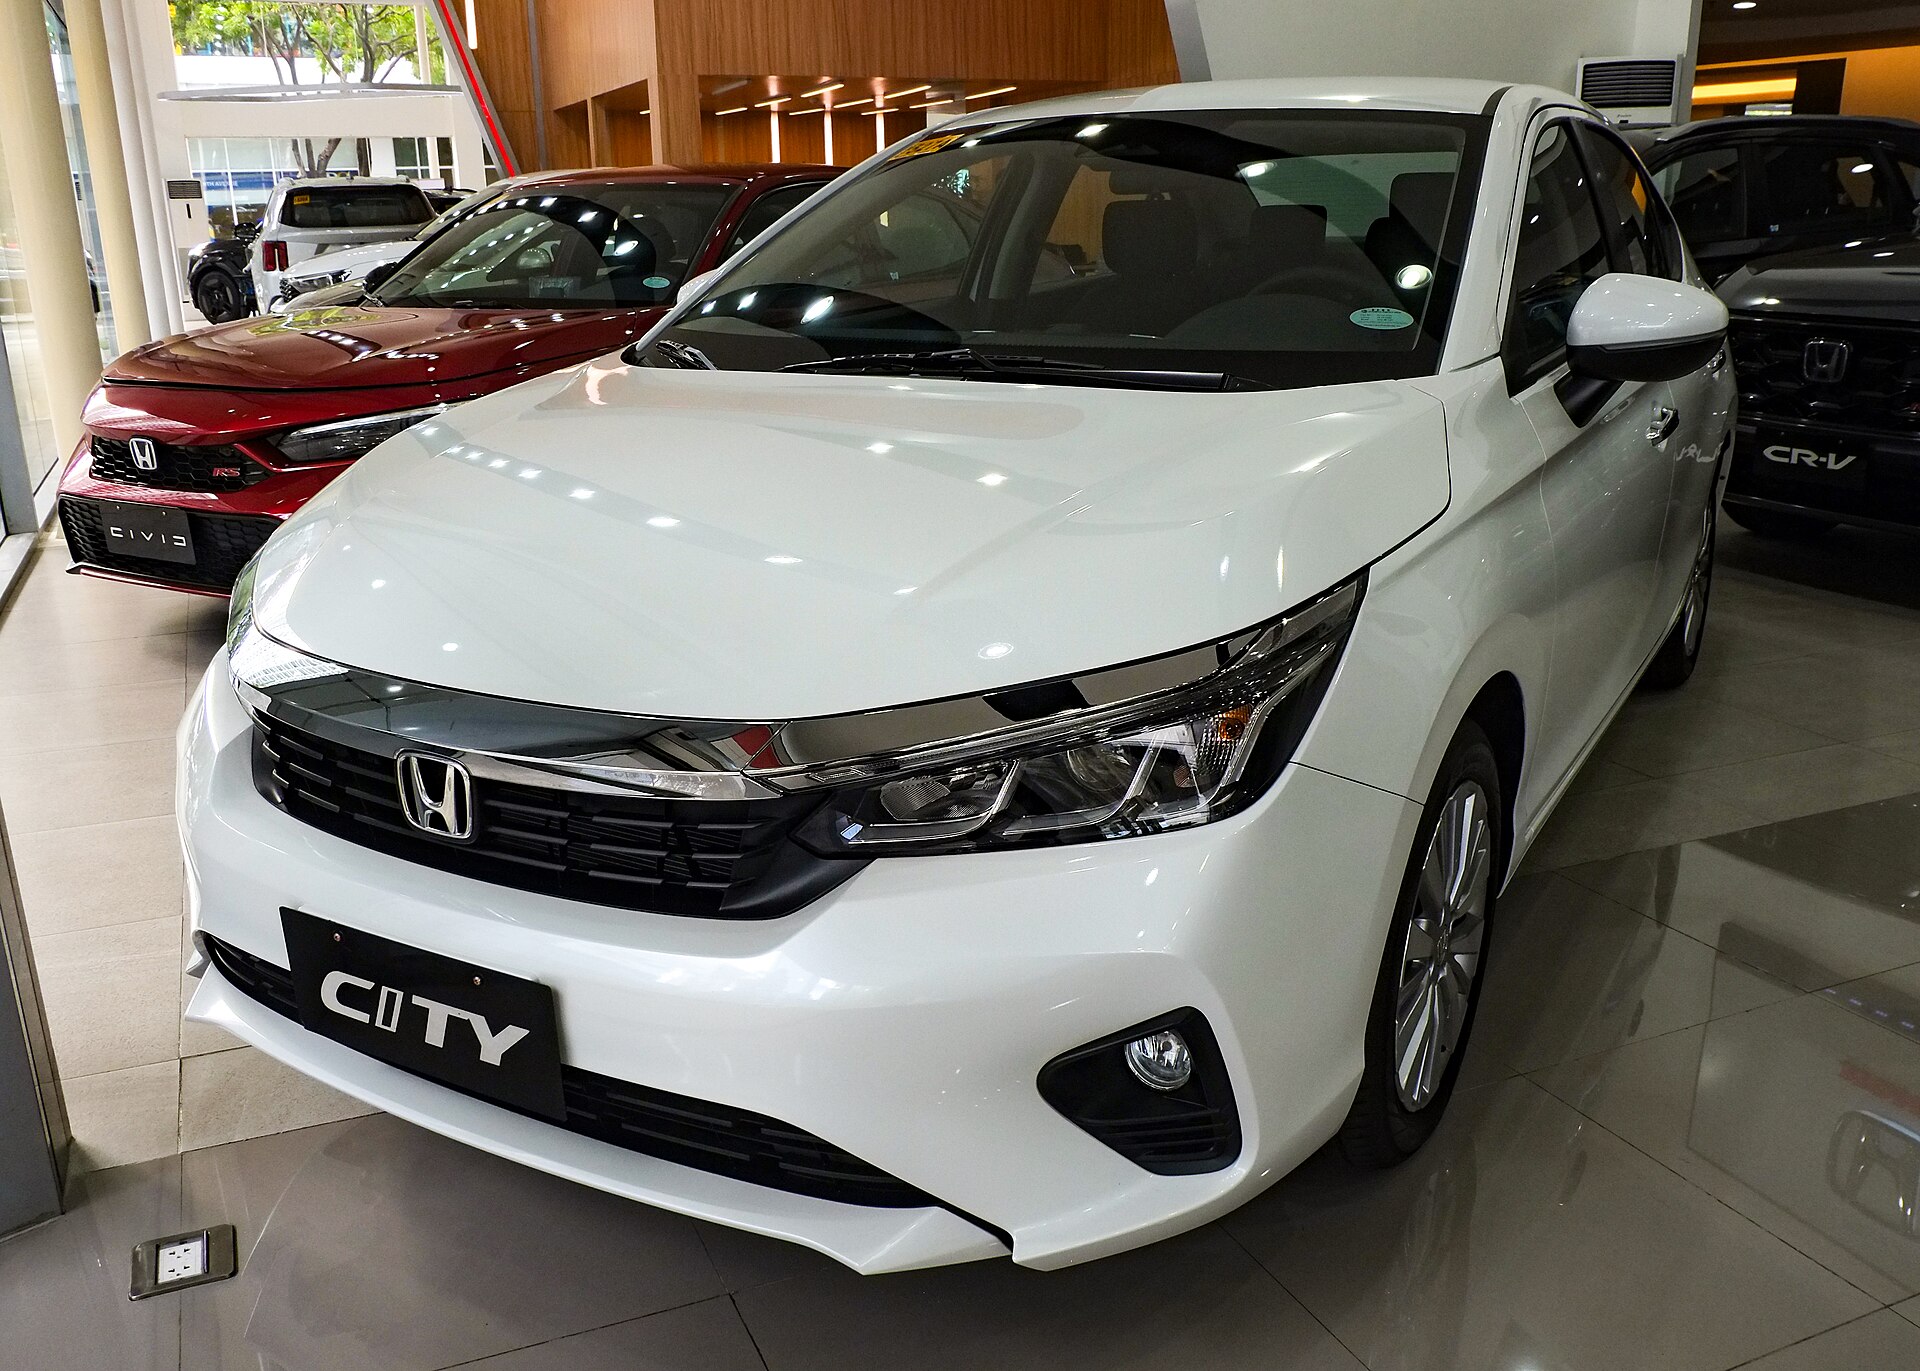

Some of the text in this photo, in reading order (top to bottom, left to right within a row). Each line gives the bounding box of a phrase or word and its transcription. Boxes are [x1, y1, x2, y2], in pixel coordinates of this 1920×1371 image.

[1762, 445, 1857, 470] CR-V
[212, 467, 240, 478] RS
[110, 526, 187, 547] CIVIC
[320, 970, 530, 1066] CITY
